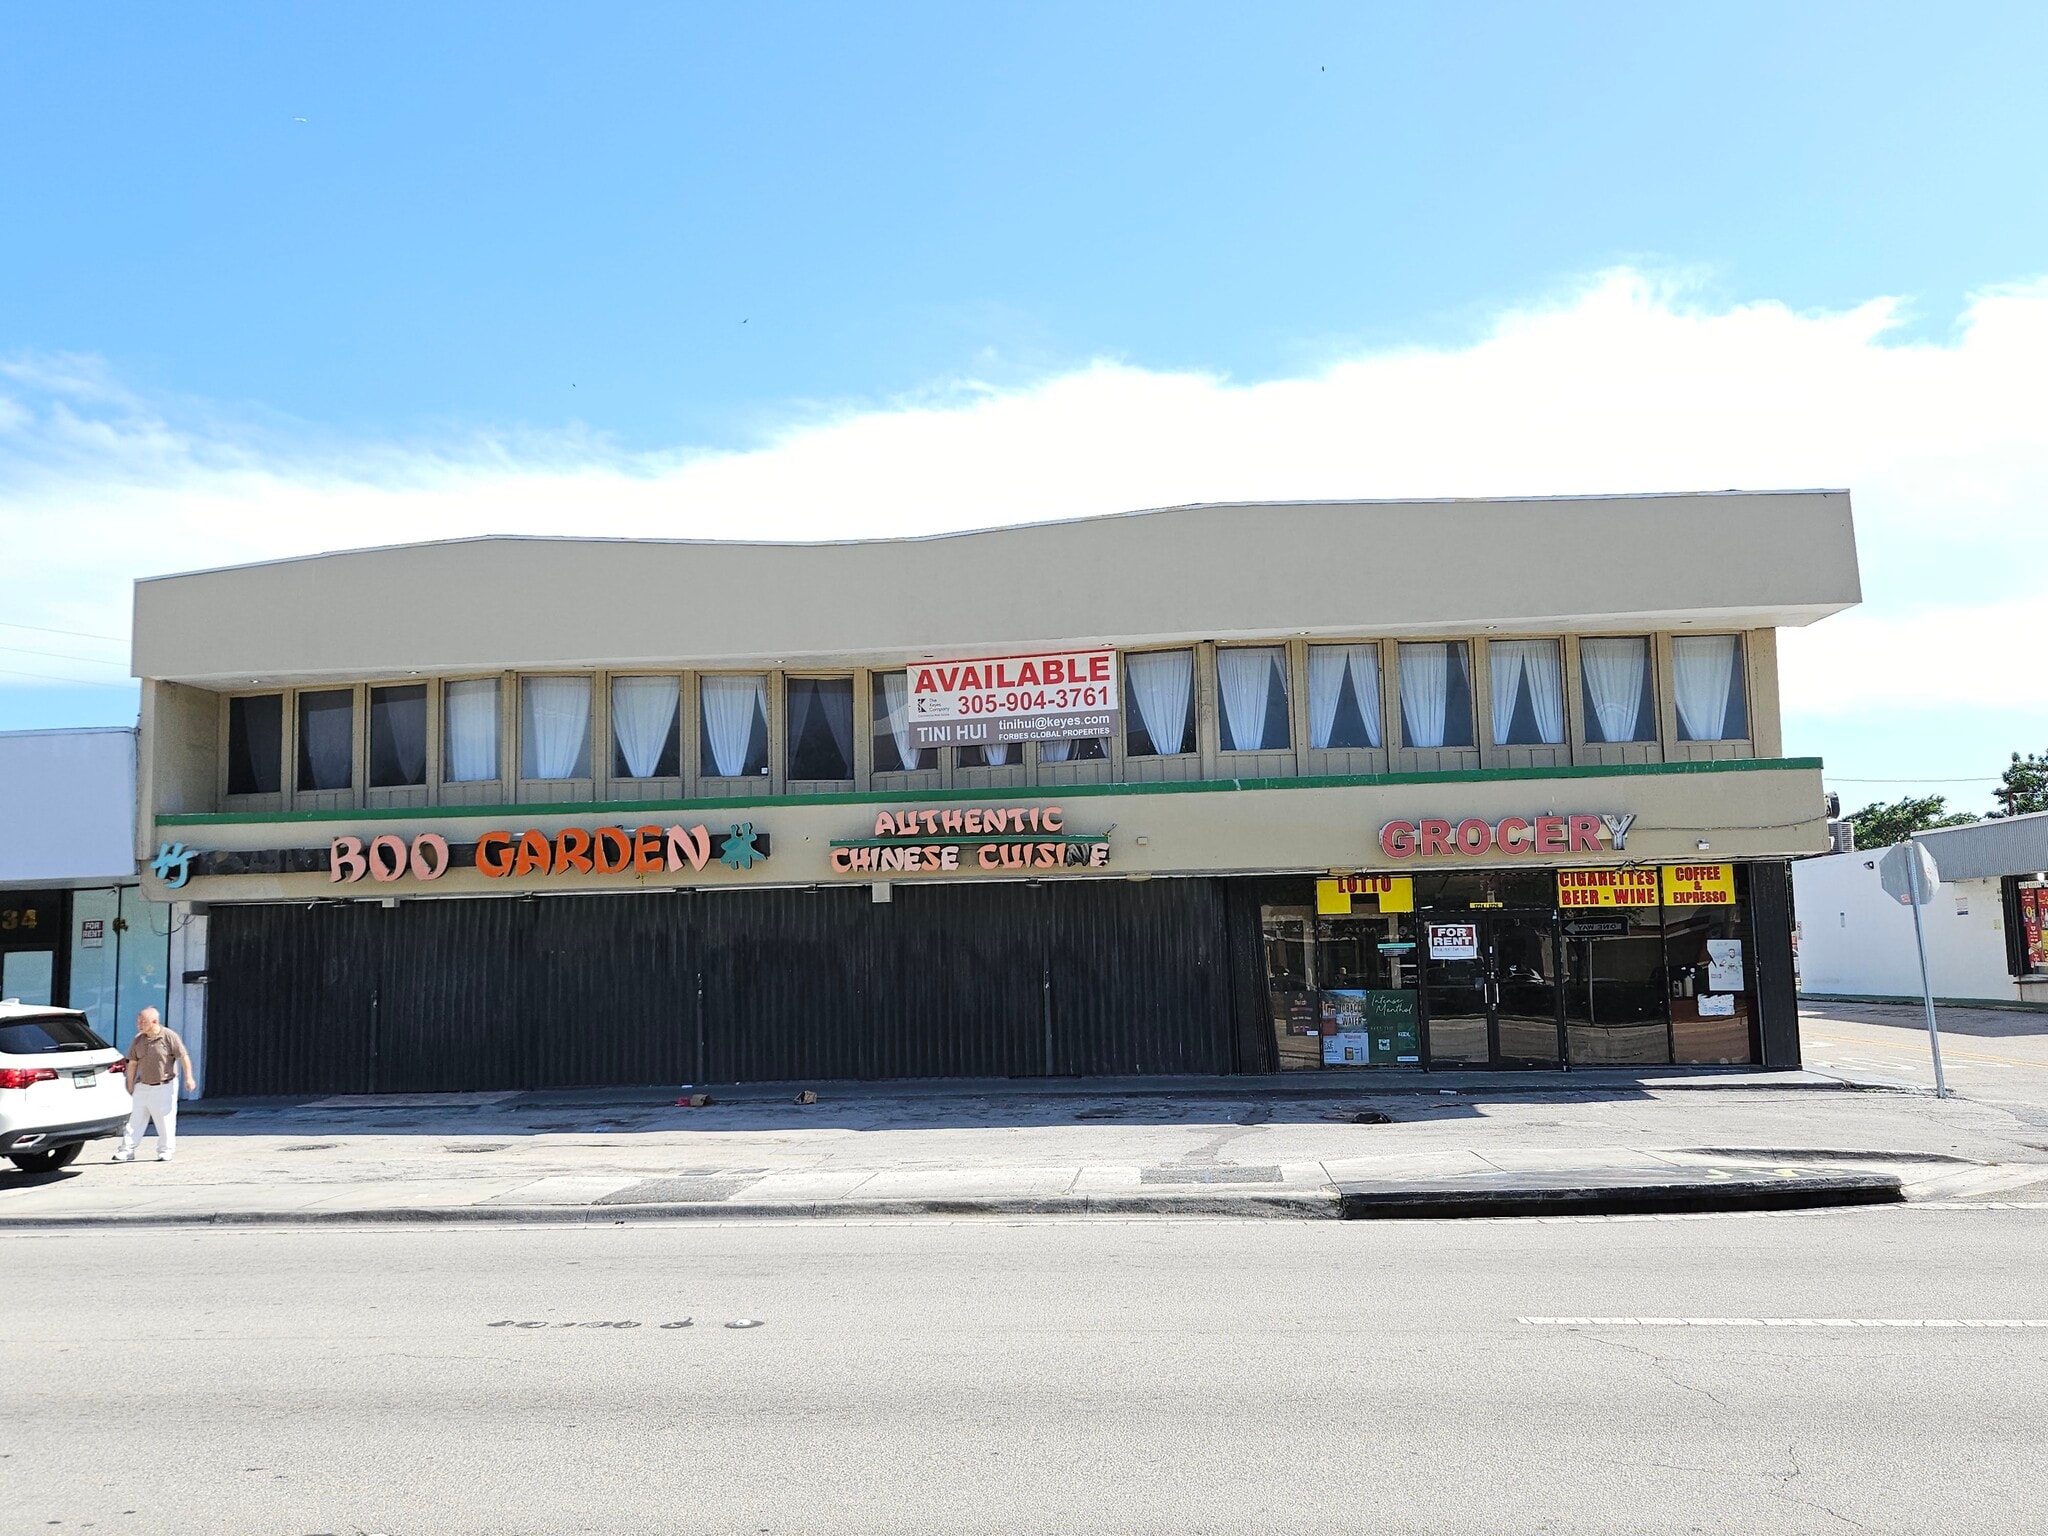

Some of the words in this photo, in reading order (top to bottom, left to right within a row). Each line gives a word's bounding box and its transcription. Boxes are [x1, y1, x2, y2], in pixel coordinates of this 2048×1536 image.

[914, 655, 1110, 694] AVAILABLE
[958, 686, 1108, 715] 305-904-3761
[999, 714, 1110, 731] tinihui@keyes.com
[917, 726, 950, 742] TINI
[957, 724, 987, 740] HUI
[999, 732, 1029, 741] FORBES
[1030, 730, 1061, 739] GLOBAL
[1062, 727, 1110, 736] PROPERTIES
[874, 806, 1063, 836] AUTHENTIC
[1380, 814, 1637, 858] GROCERY
[329, 832, 449, 883] BOO
[475, 824, 711, 877] GARDEN
[829, 846, 960, 874] CHINESE
[976, 842, 1110, 870] CUISINE
[1559, 871, 1655, 887] CIGARETTES
[1675, 866, 1720, 881] COFFEE
[1338, 876, 1391, 893] LOTTO
[1694, 881, 1702, 890] &
[1561, 889, 1599, 905] BEER
[1613, 888, 1655, 904] WINE
[1673, 891, 1727, 904] EXPRESSO
[82, 930, 102, 938] RENT
[85, 922, 100, 930] FOR
[1437, 928, 1467, 937] FOR
[1433, 936, 1472, 946] RENT
[1371, 995, 1403, 1007] Intense
[1376, 1003, 1413, 1016] Menthol
